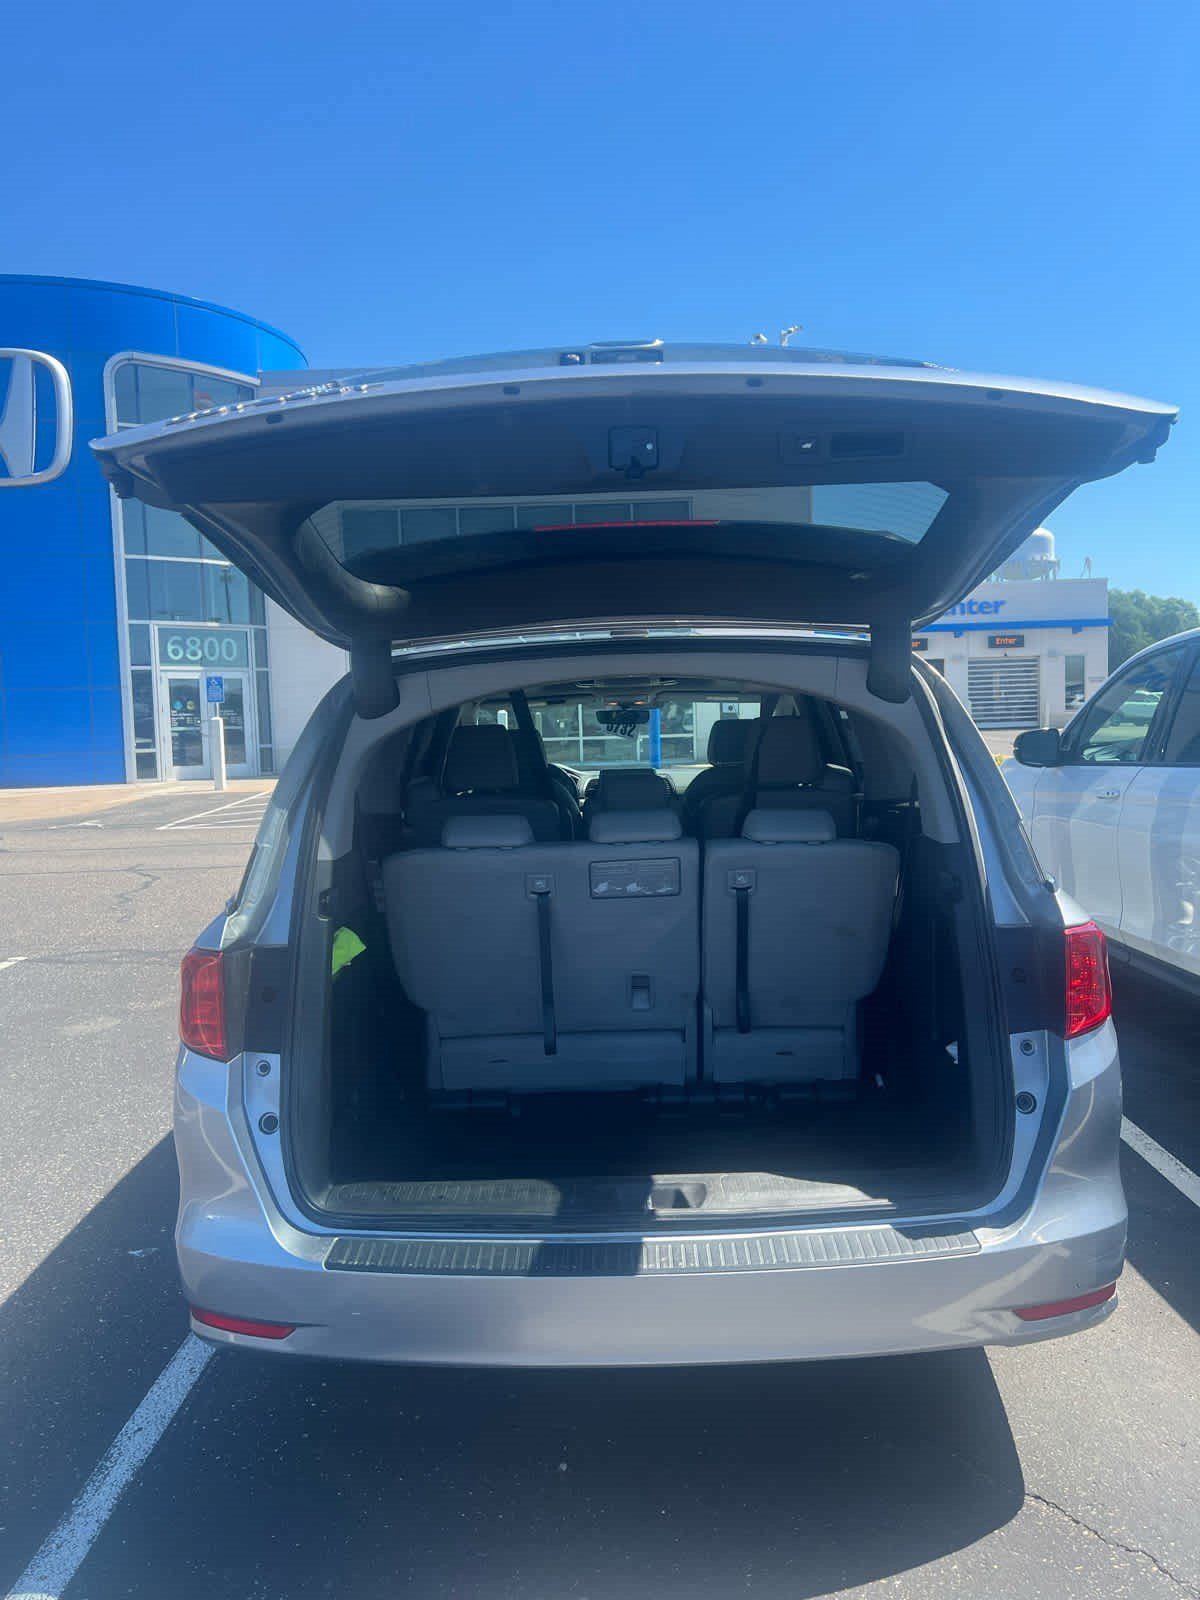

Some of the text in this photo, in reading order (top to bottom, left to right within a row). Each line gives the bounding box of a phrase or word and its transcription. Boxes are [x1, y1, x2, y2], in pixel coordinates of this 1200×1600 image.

[944, 599, 1007, 615] nter
[167, 636, 237, 661] 6800
[995, 637, 1017, 645] Enter
